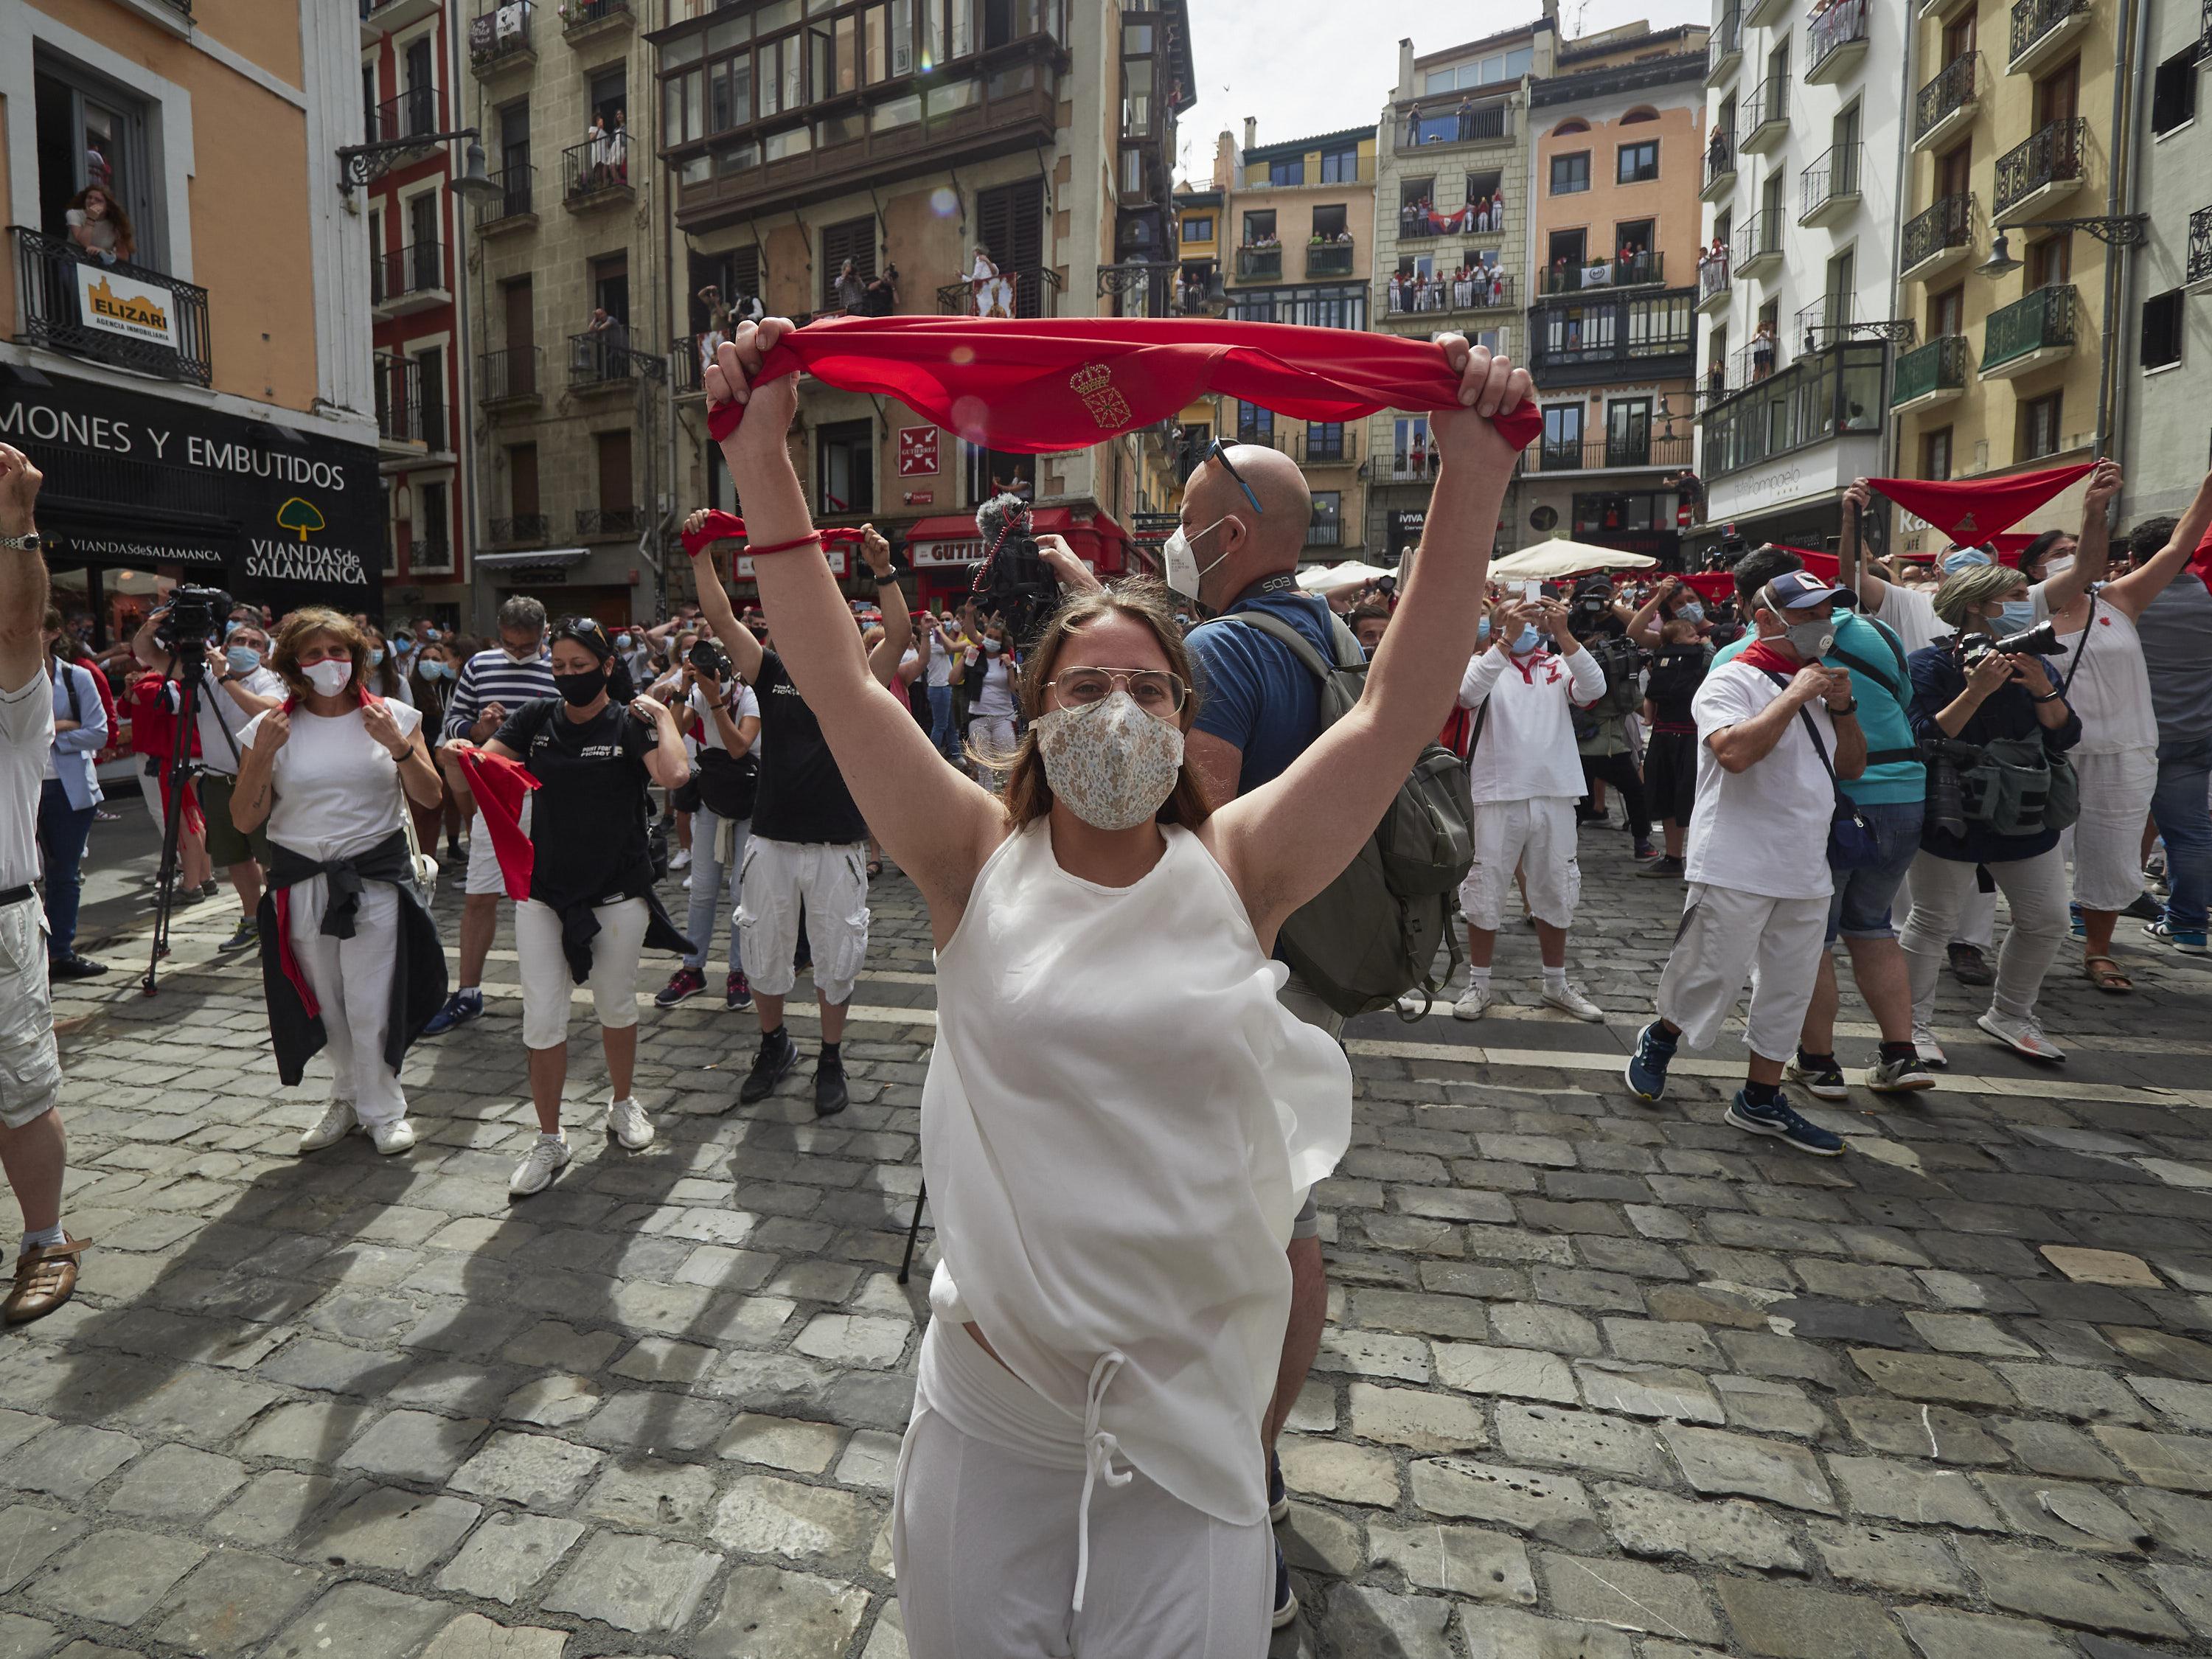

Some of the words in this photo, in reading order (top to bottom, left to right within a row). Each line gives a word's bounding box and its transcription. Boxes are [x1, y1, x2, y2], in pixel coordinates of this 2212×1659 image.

[94, 298, 168, 329] ELIZARI
[97, 317, 125, 330] AGENCIA
[126, 325, 170, 341] INMOBILIARIA
[146, 428, 170, 459] Y
[187, 436, 346, 491] EMBUTIDOS
[1899, 508, 1933, 534] Ka
[246, 556, 368, 585] SALAMANCA
[1262, 576, 1292, 592] EOS
